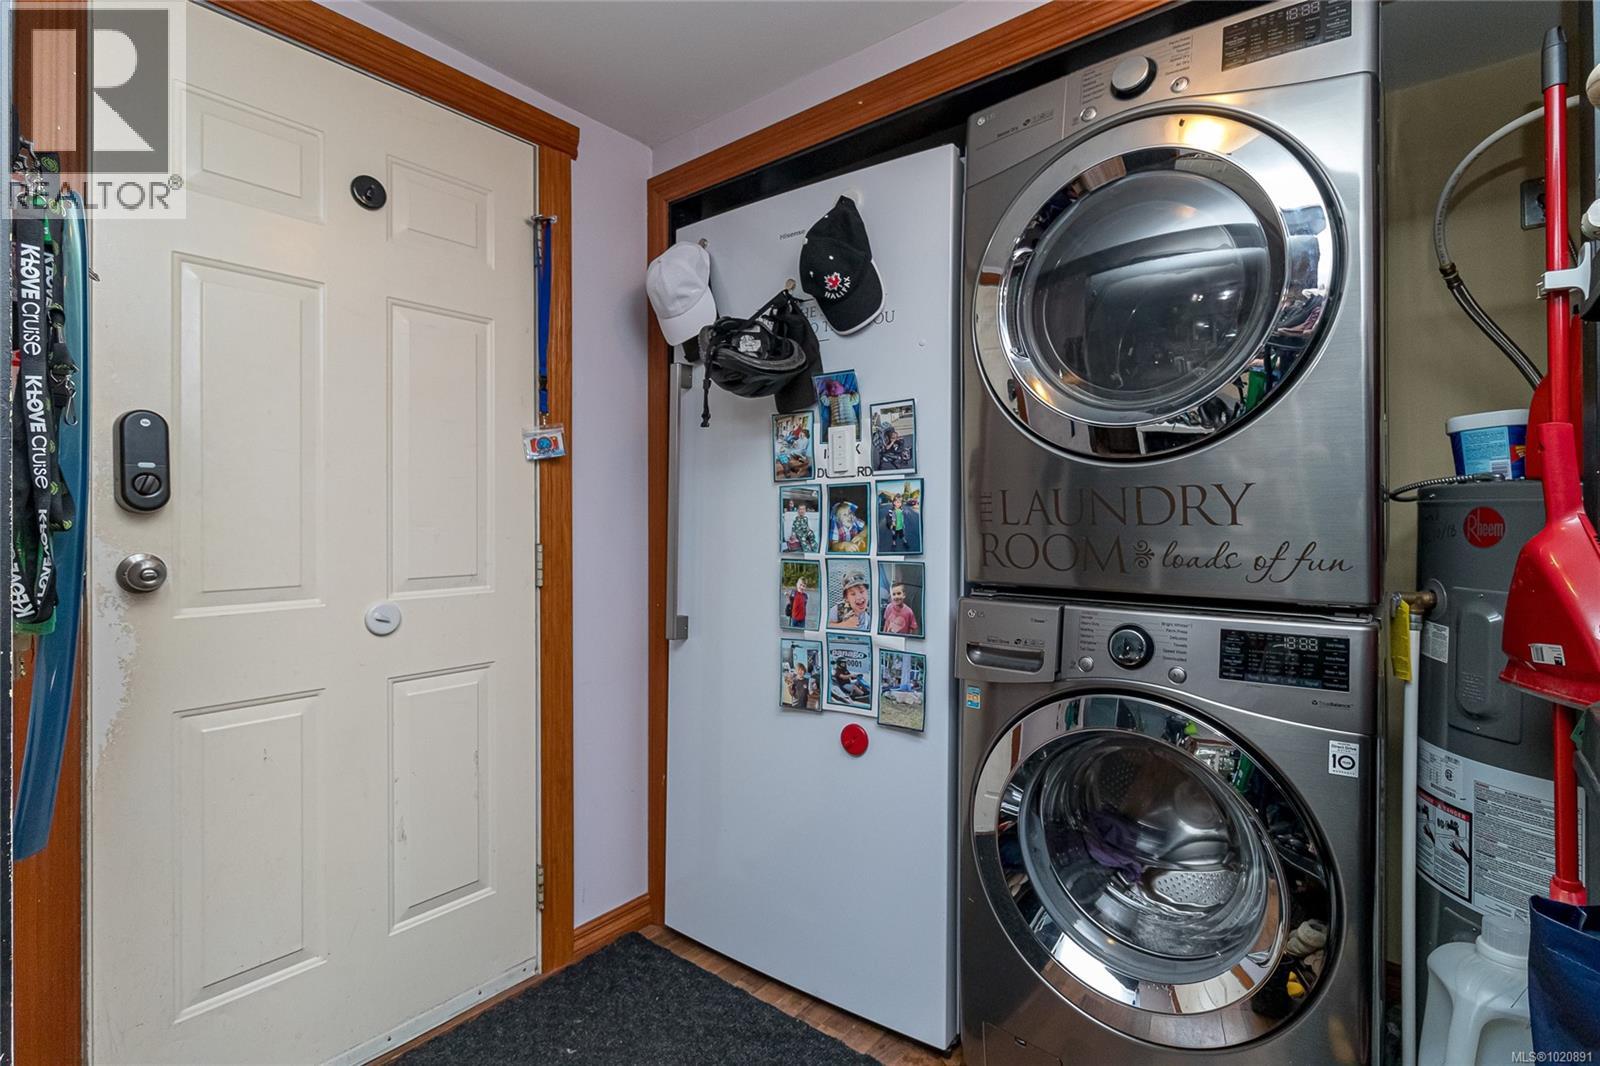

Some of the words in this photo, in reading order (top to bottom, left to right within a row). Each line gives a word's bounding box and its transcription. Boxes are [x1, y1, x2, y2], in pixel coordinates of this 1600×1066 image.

[824, 276, 851, 300] HALIFAX
[1000, 482, 1257, 527] LAUNDRY
[1467, 507, 1504, 543] Rheem
[980, 532, 1130, 575] ROOM
[1161, 540, 1243, 570] loads
[1245, 541, 1288, 584] of
[1283, 541, 1354, 584] fun
[1331, 753, 1356, 771] 10
